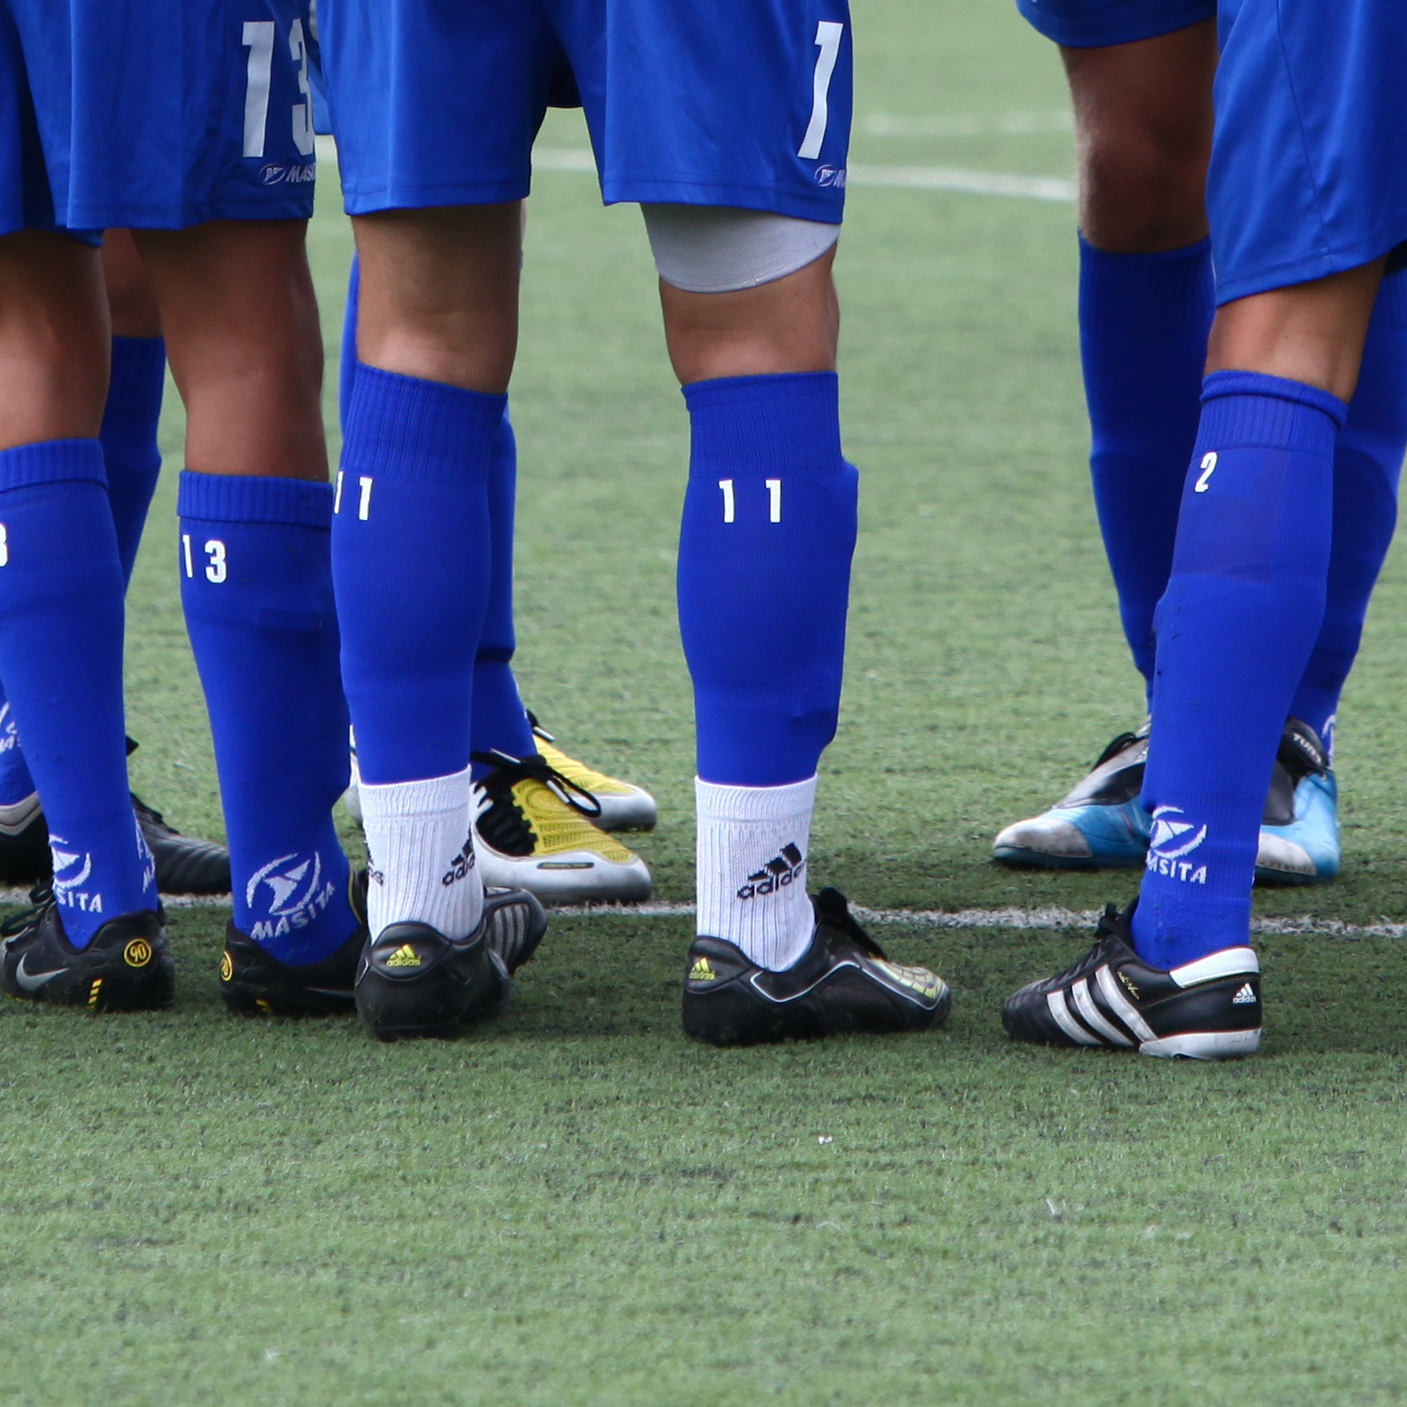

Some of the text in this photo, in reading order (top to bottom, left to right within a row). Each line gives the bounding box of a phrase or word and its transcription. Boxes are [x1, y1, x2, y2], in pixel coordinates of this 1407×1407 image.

[797, 20, 844, 160] 1
[334, 470, 374, 521] 11
[1194, 451, 1218, 493] 2
[719, 478, 782, 523] 11
[182, 534, 227, 584] 13
[250, 881, 336, 941] MASITA
